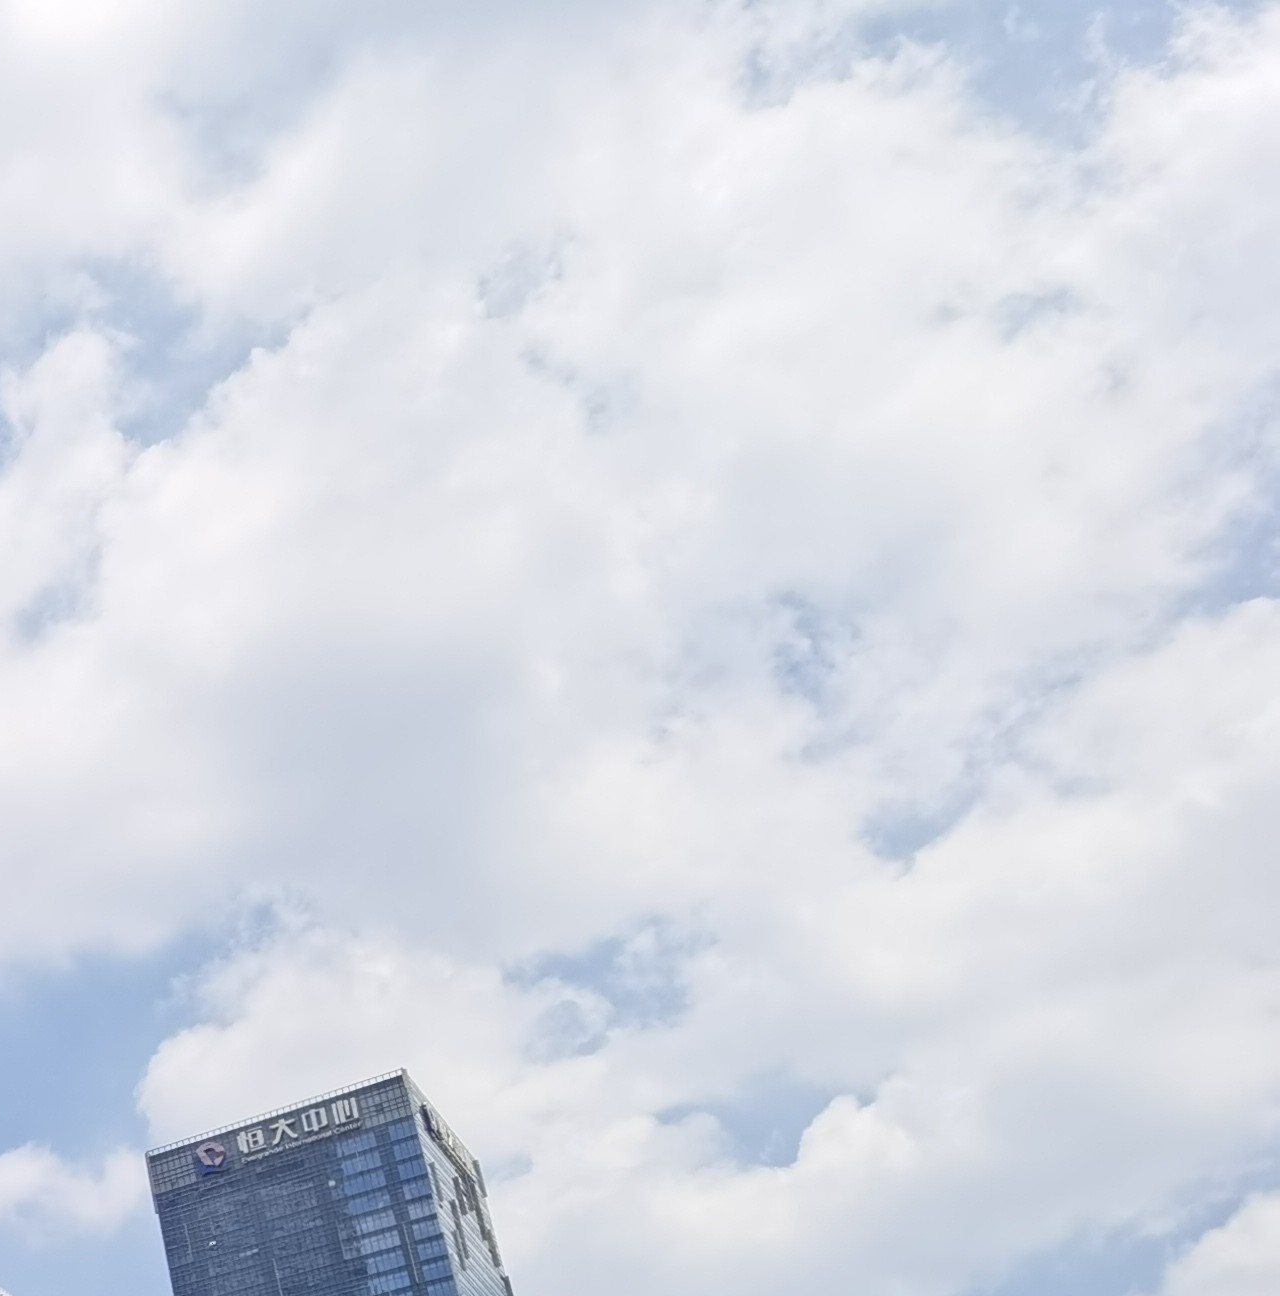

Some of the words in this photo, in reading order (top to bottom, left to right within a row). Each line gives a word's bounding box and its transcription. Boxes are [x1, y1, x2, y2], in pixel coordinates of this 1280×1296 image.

[236, 1097, 359, 1153] 恒大中心
[334, 1120, 363, 1134] Center
